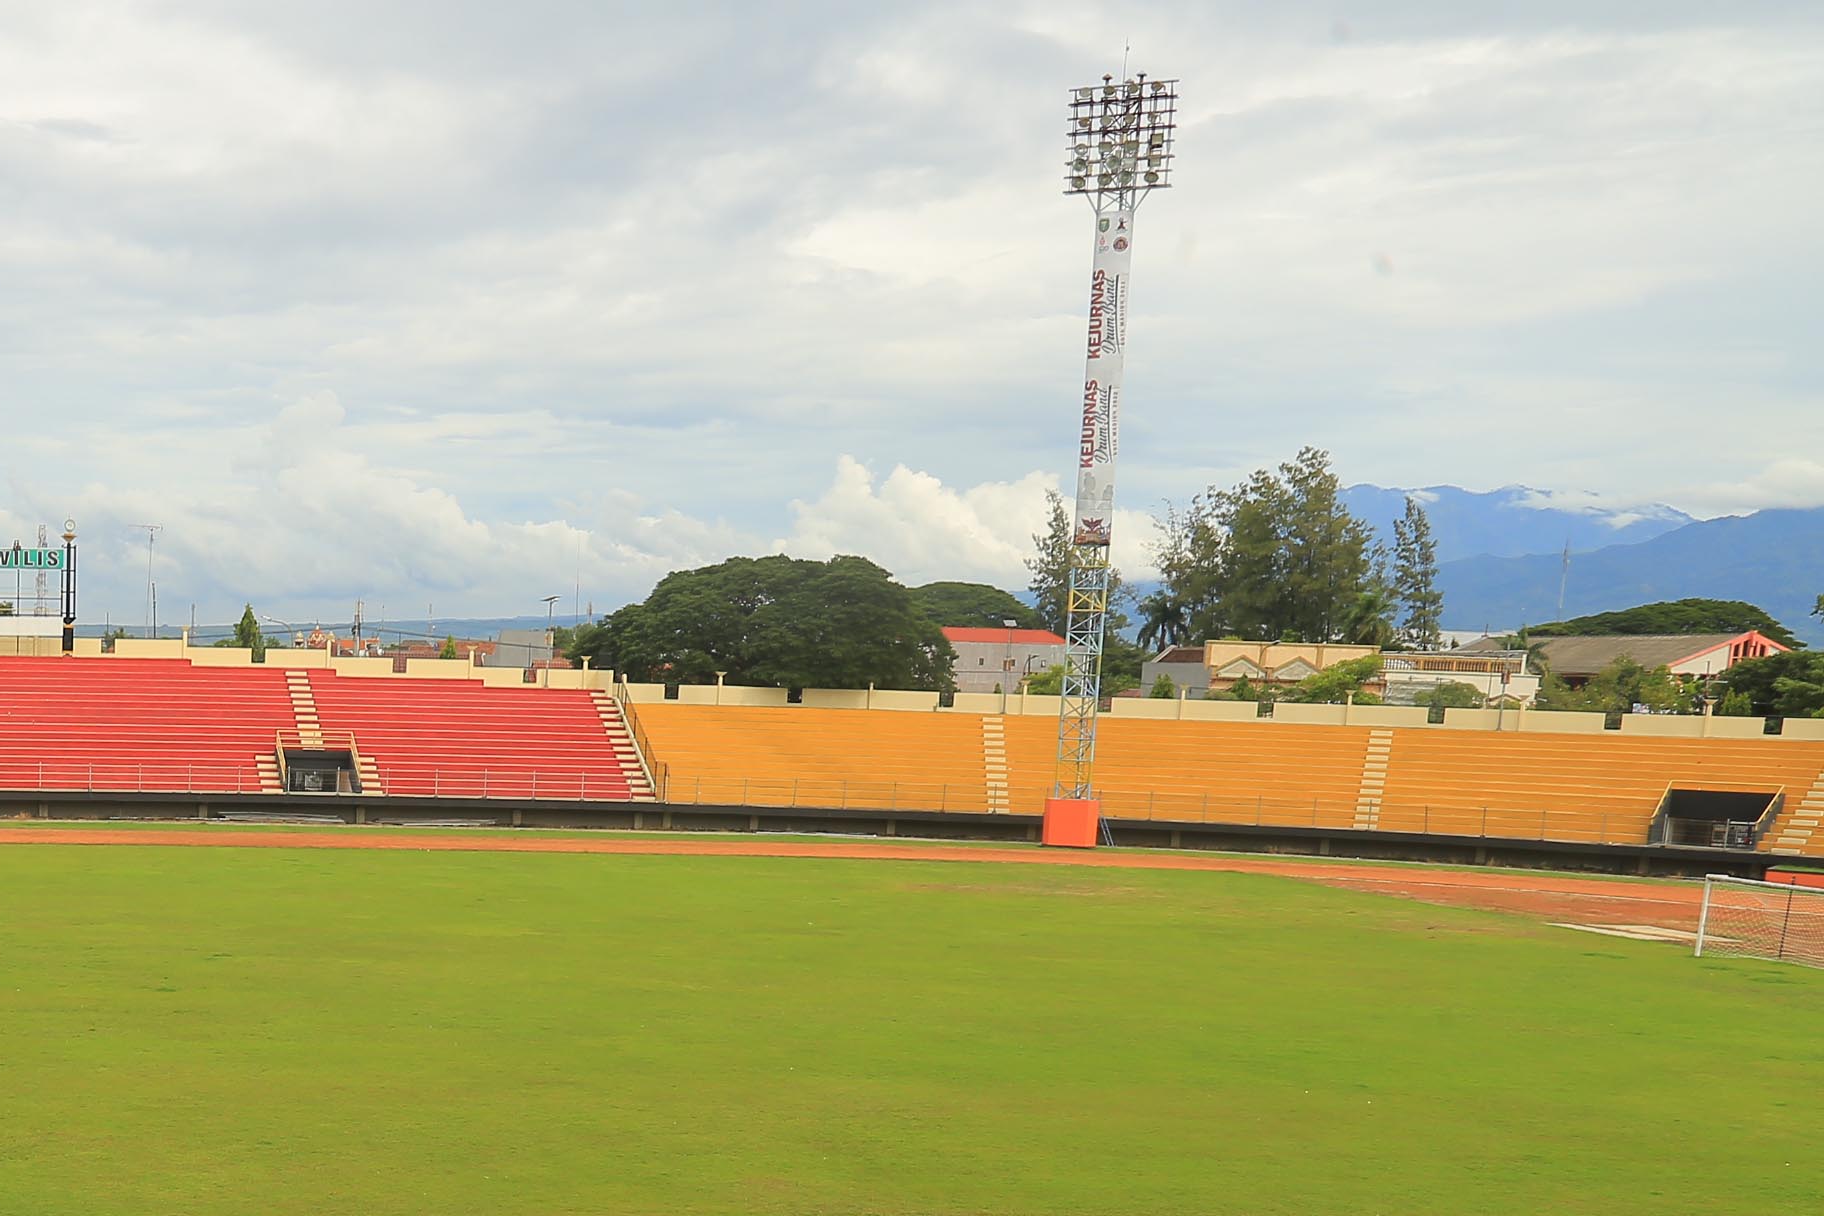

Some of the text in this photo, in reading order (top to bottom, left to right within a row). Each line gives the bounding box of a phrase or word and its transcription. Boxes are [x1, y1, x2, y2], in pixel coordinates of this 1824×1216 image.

[1088, 268, 1106, 360] KEJURNAS
[1101, 276, 1116, 354] Drum Band
[1080, 379, 1098, 468] KEJURNAS
[1094, 386, 1109, 464] Drum Band
